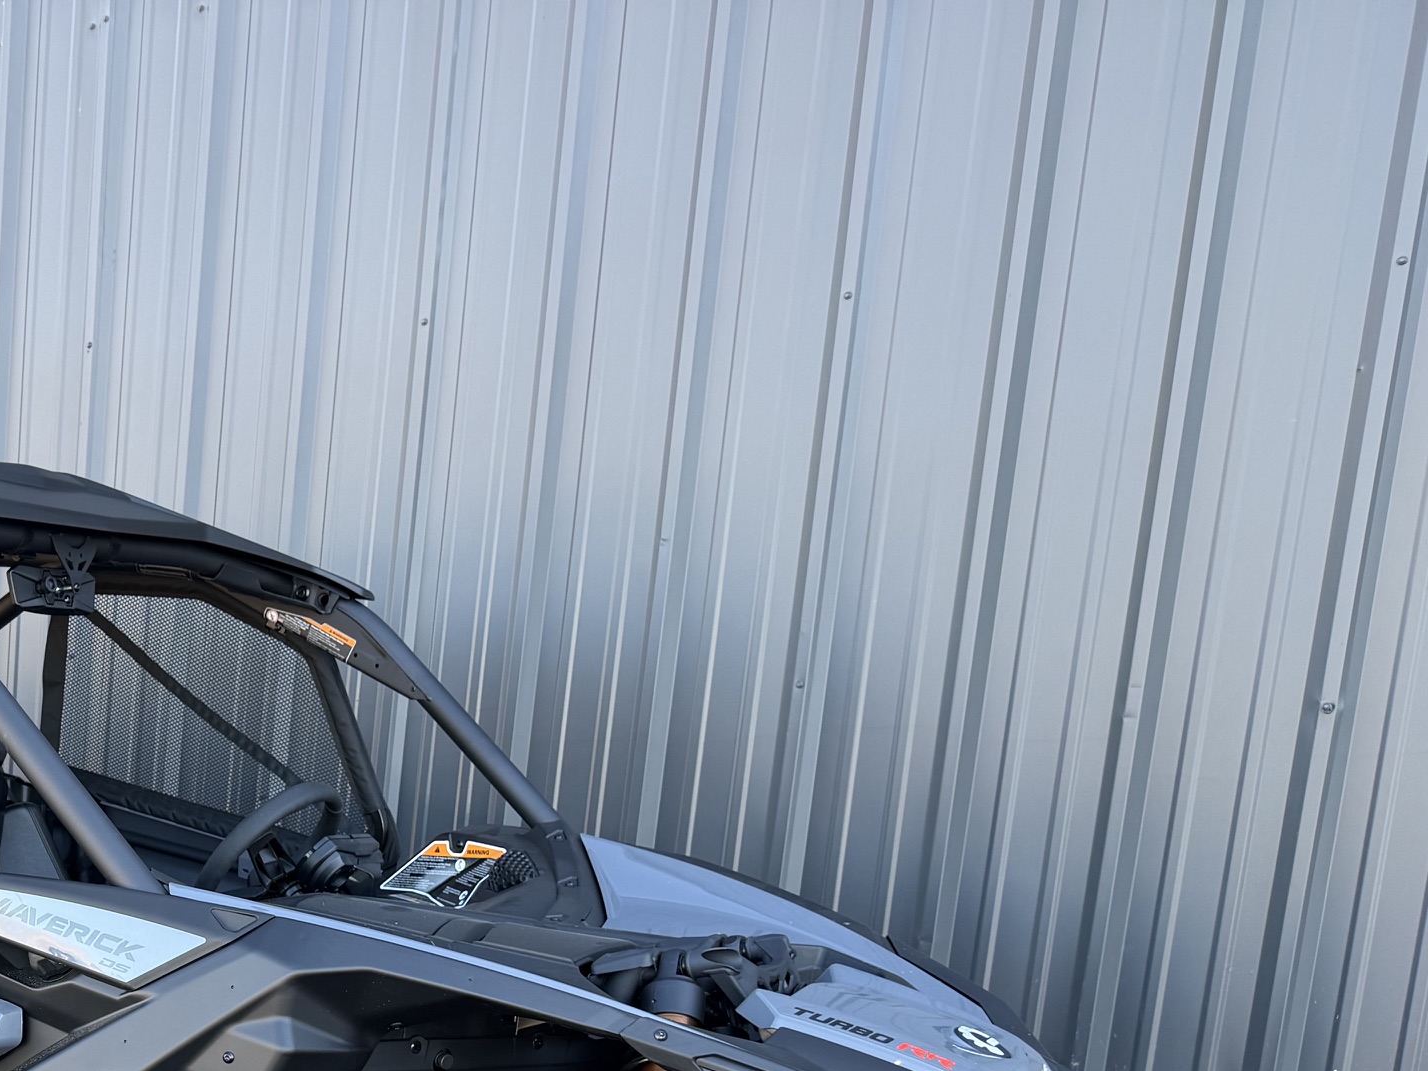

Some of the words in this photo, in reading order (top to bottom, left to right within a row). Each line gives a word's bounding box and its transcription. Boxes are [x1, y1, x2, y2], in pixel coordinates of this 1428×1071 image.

[98, 957, 132, 974] DS
[793, 1006, 894, 1045] TURBO
[896, 1042, 956, 1071] RR
